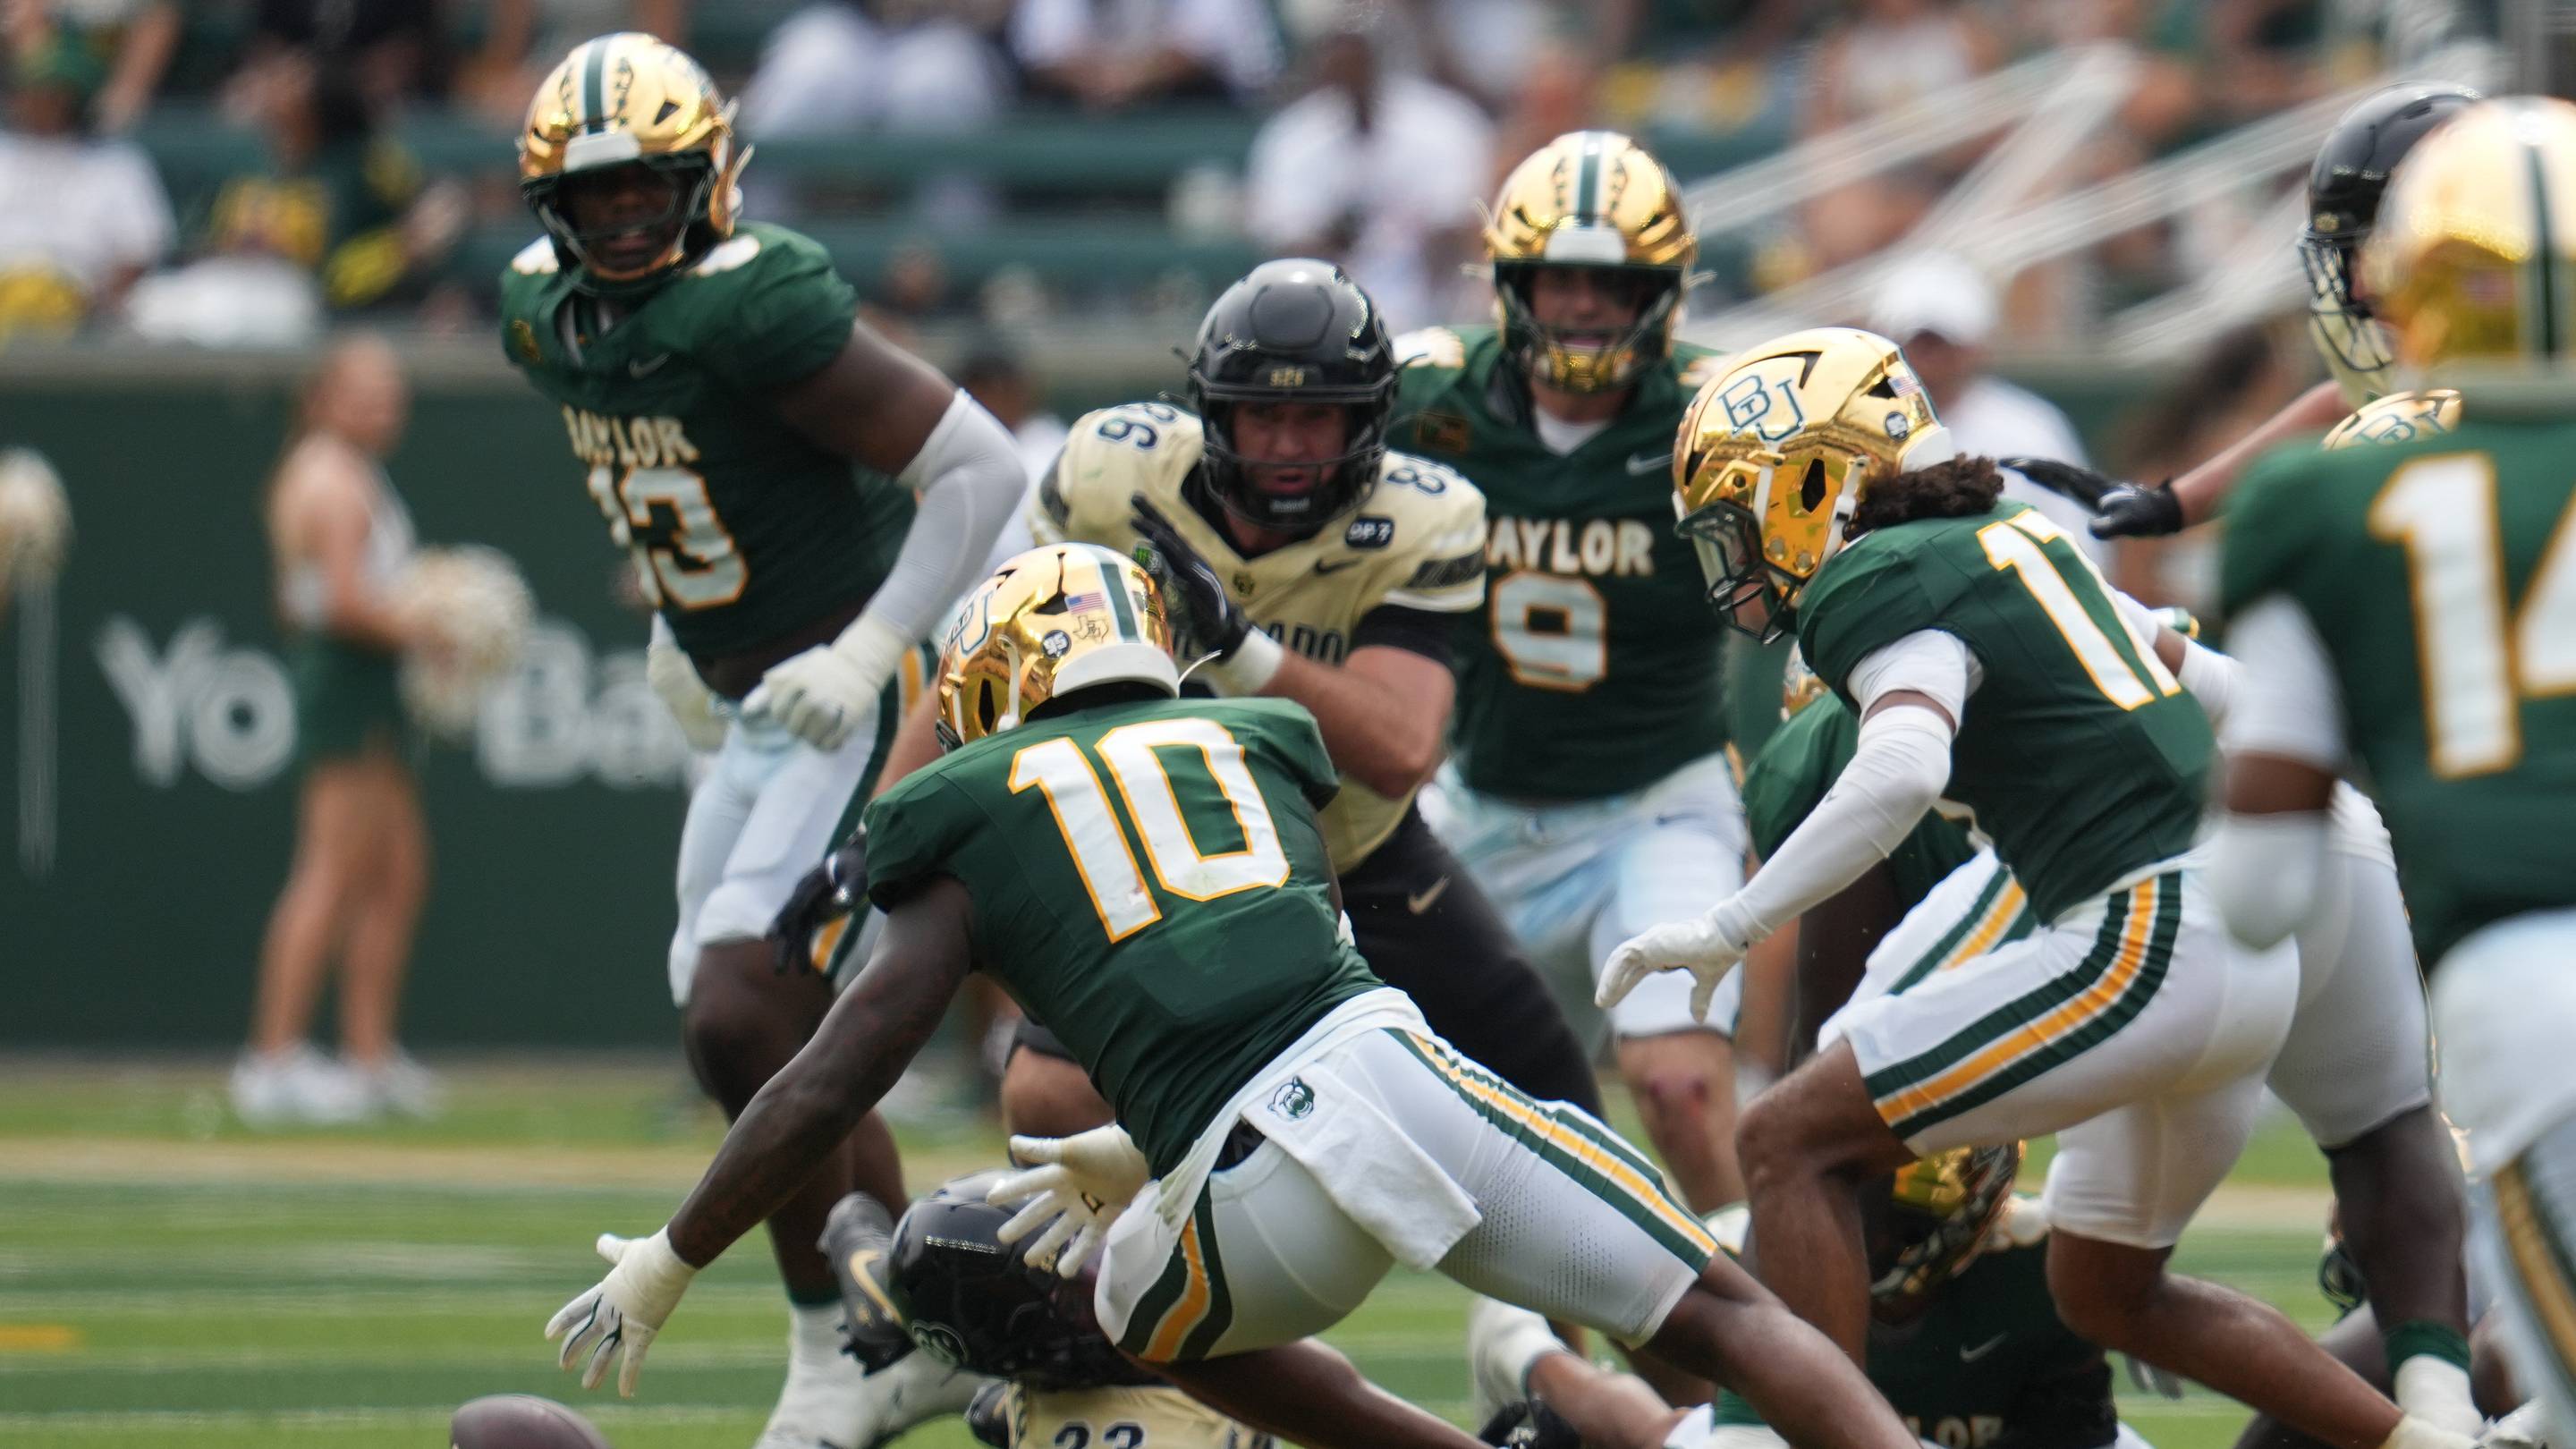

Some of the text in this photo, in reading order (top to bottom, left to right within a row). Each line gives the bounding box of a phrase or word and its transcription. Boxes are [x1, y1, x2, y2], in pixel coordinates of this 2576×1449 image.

[1716, 375, 1804, 442] BU
[1486, 518, 1656, 577] AYLOR
[1489, 569, 1607, 692] 9
[1007, 717, 1291, 945] 10
